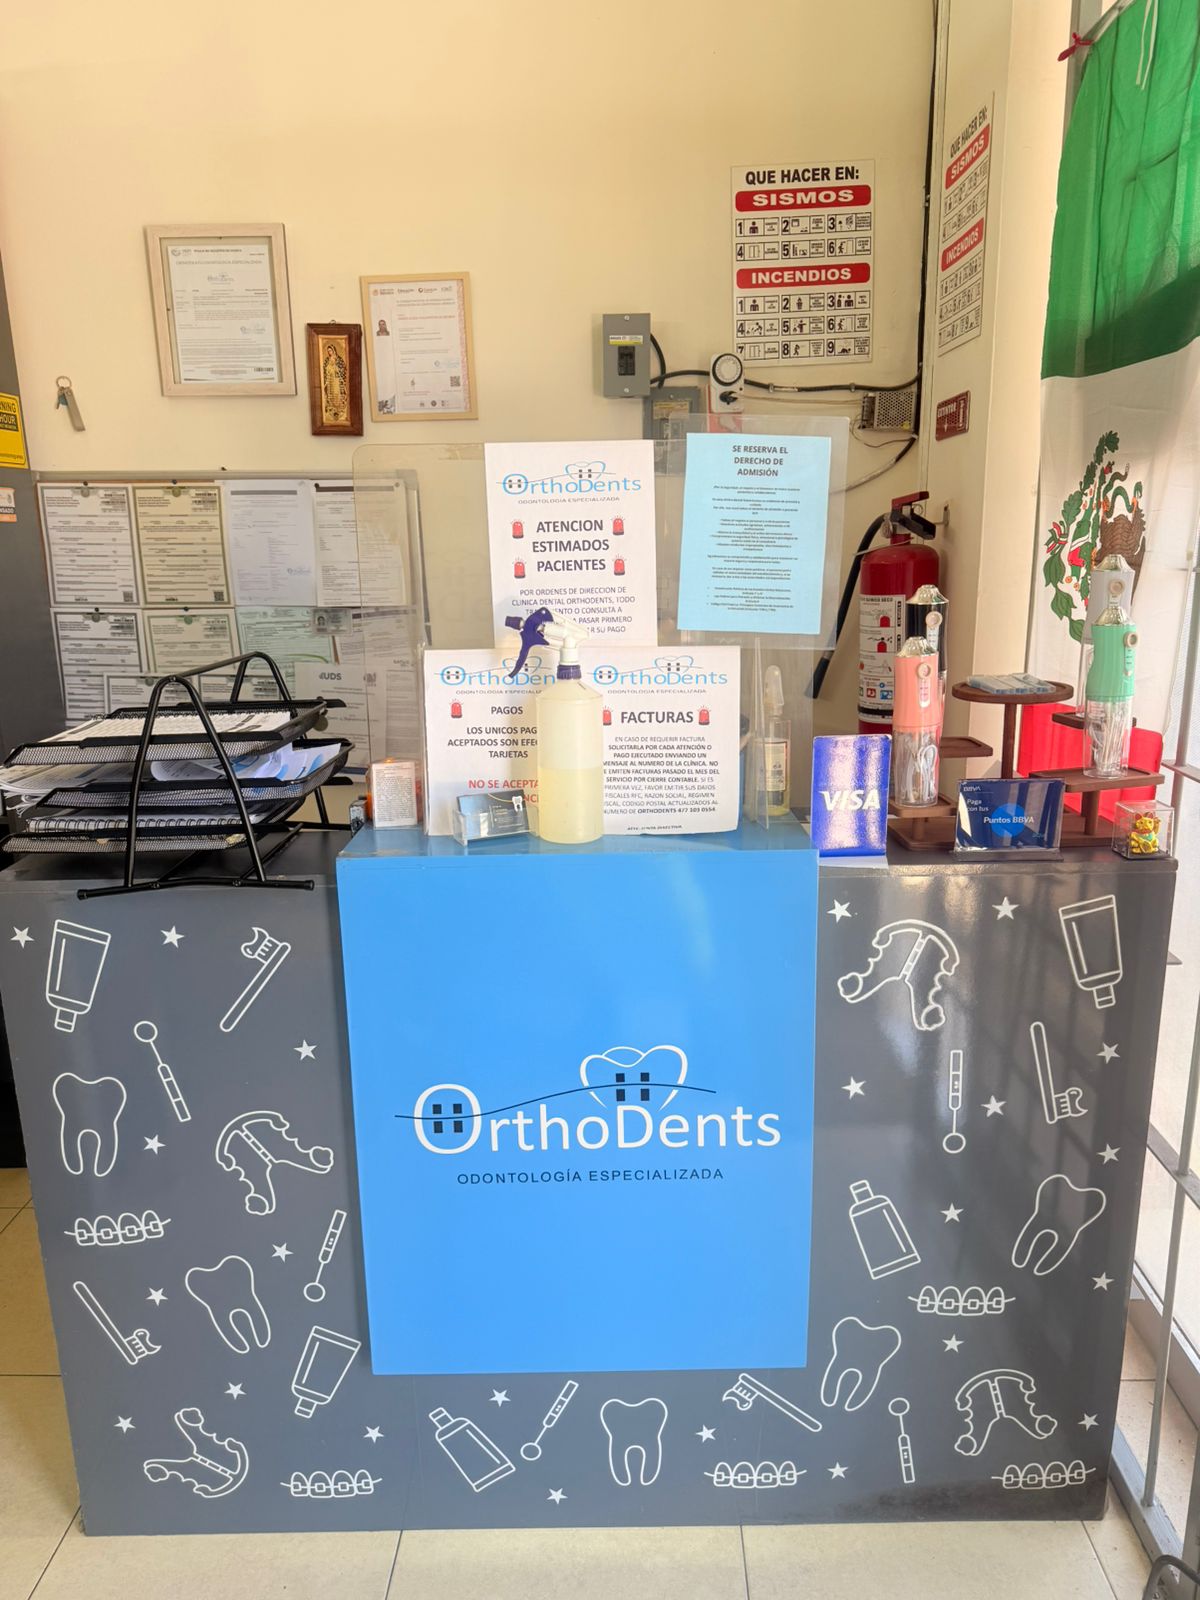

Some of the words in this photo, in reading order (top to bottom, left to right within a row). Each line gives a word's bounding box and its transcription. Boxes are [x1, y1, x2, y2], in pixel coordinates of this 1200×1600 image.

[950, 136, 961, 158] QUE
[961, 115, 978, 146] HACER
[951, 134, 985, 179] SISMOS
[745, 170, 776, 185] QUE
[781, 167, 831, 183] HACER
[835, 166, 859, 180] EN:
[752, 189, 855, 207] SISMOS
[737, 221, 743, 235] 1
[781, 219, 789, 233] 2
[828, 217, 836, 230] 3
[782, 244, 790, 257] 5
[828, 241, 835, 254] 6
[946, 226, 980, 265] INCENDIOS
[737, 246, 744, 259] 4
[751, 267, 852, 285] INCENDIOS
[738, 299, 744, 312] 1
[782, 297, 789, 310] 2
[828, 295, 835, 308] 3
[737, 323, 745, 335] 4
[782, 320, 789, 333] 5
[828, 318, 835, 331] 6
[782, 343, 789, 356] 8
[827, 341, 835, 354] 9
[732, 445, 742, 453] SE
[743, 445, 778, 454] RESERVA
[779, 446, 788, 454] EL
[733, 456, 772, 465] DERECHO
[773, 457, 784, 466] DE
[737, 467, 779, 477] ADMISIÓN
[502, 473, 642, 495] OrthoDents
[536, 519, 604, 533] ATENCION
[532, 538, 610, 553] ESTIMADOS
[537, 558, 606, 572] PACIENTES
[535, 588, 568, 596] ORDENES
[568, 587, 578, 595] DE
[579, 587, 616, 595] DIRECCION
[617, 586, 627, 594] DE
[539, 598, 565, 606] DENTAL
[581, 607, 616, 615] CONSULTA
[440, 665, 556, 686] OrthoDen
[593, 665, 729, 685] OrthoDents
[490, 706, 524, 715] PAGOS
[620, 711, 694, 724] FACTURAS
[466, 726, 483, 735] LOS
[485, 726, 519, 734] UNICOS
[520, 726, 538, 734] PAG
[447, 738, 499, 747] ACEPTADOS
[500, 738, 519, 747] SON
[488, 750, 528, 759] TARJETAS
[468, 779, 485, 789] NO
[487, 779, 500, 788] SE
[818, 788, 882, 811] VISA
[966, 798, 982, 806] Paga
[983, 816, 1011, 824] Puntos
[413, 1083, 782, 1155] OrthoDents
[457, 1167, 582, 1185] ODONTOLOGÍA
[588, 1166, 724, 1183] ESPECIALIZADA
